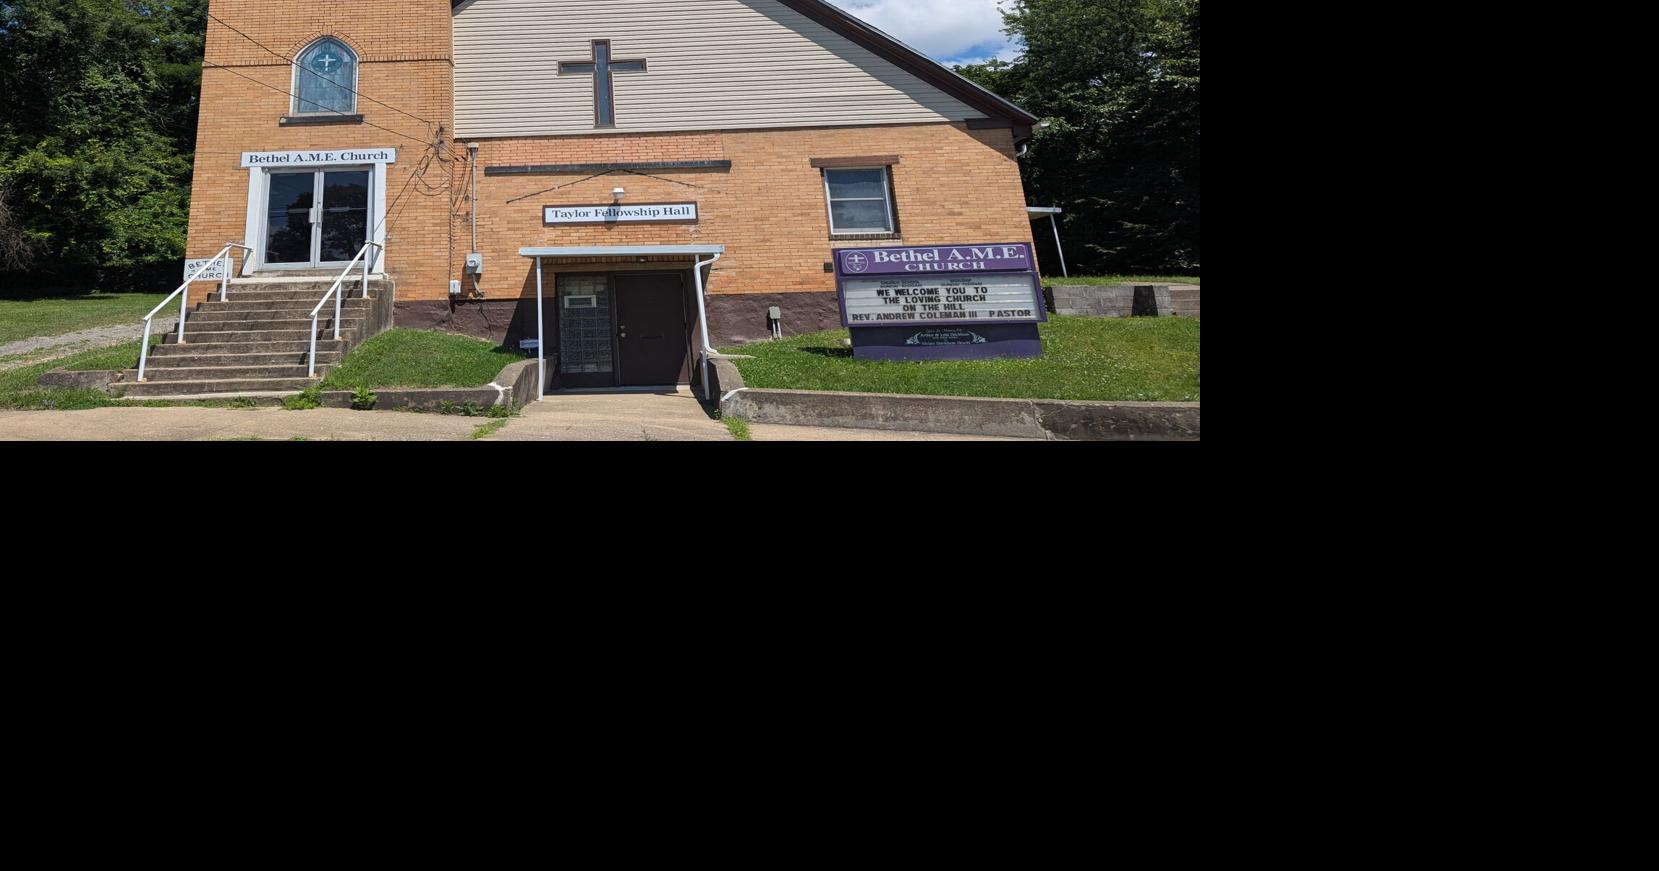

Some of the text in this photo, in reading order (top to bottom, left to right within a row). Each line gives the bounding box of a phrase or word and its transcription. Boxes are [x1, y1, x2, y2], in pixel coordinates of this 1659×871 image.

[249, 150, 388, 164] Bethel A.M.E. Church
[551, 206, 690, 220] Taylor Fellowship Hall
[873, 246, 1025, 263] Bethel A.M.E.
[187, 260, 225, 270] BETE
[904, 261, 985, 271] CHURCH
[894, 288, 939, 296] WELCOME
[974, 286, 988, 294] TO
[902, 304, 917, 312] ON
[943, 303, 966, 311] HILL
[852, 313, 874, 321] REV.
[876, 312, 915, 320] ANDREW
[919, 311, 966, 319] COLEMAN
